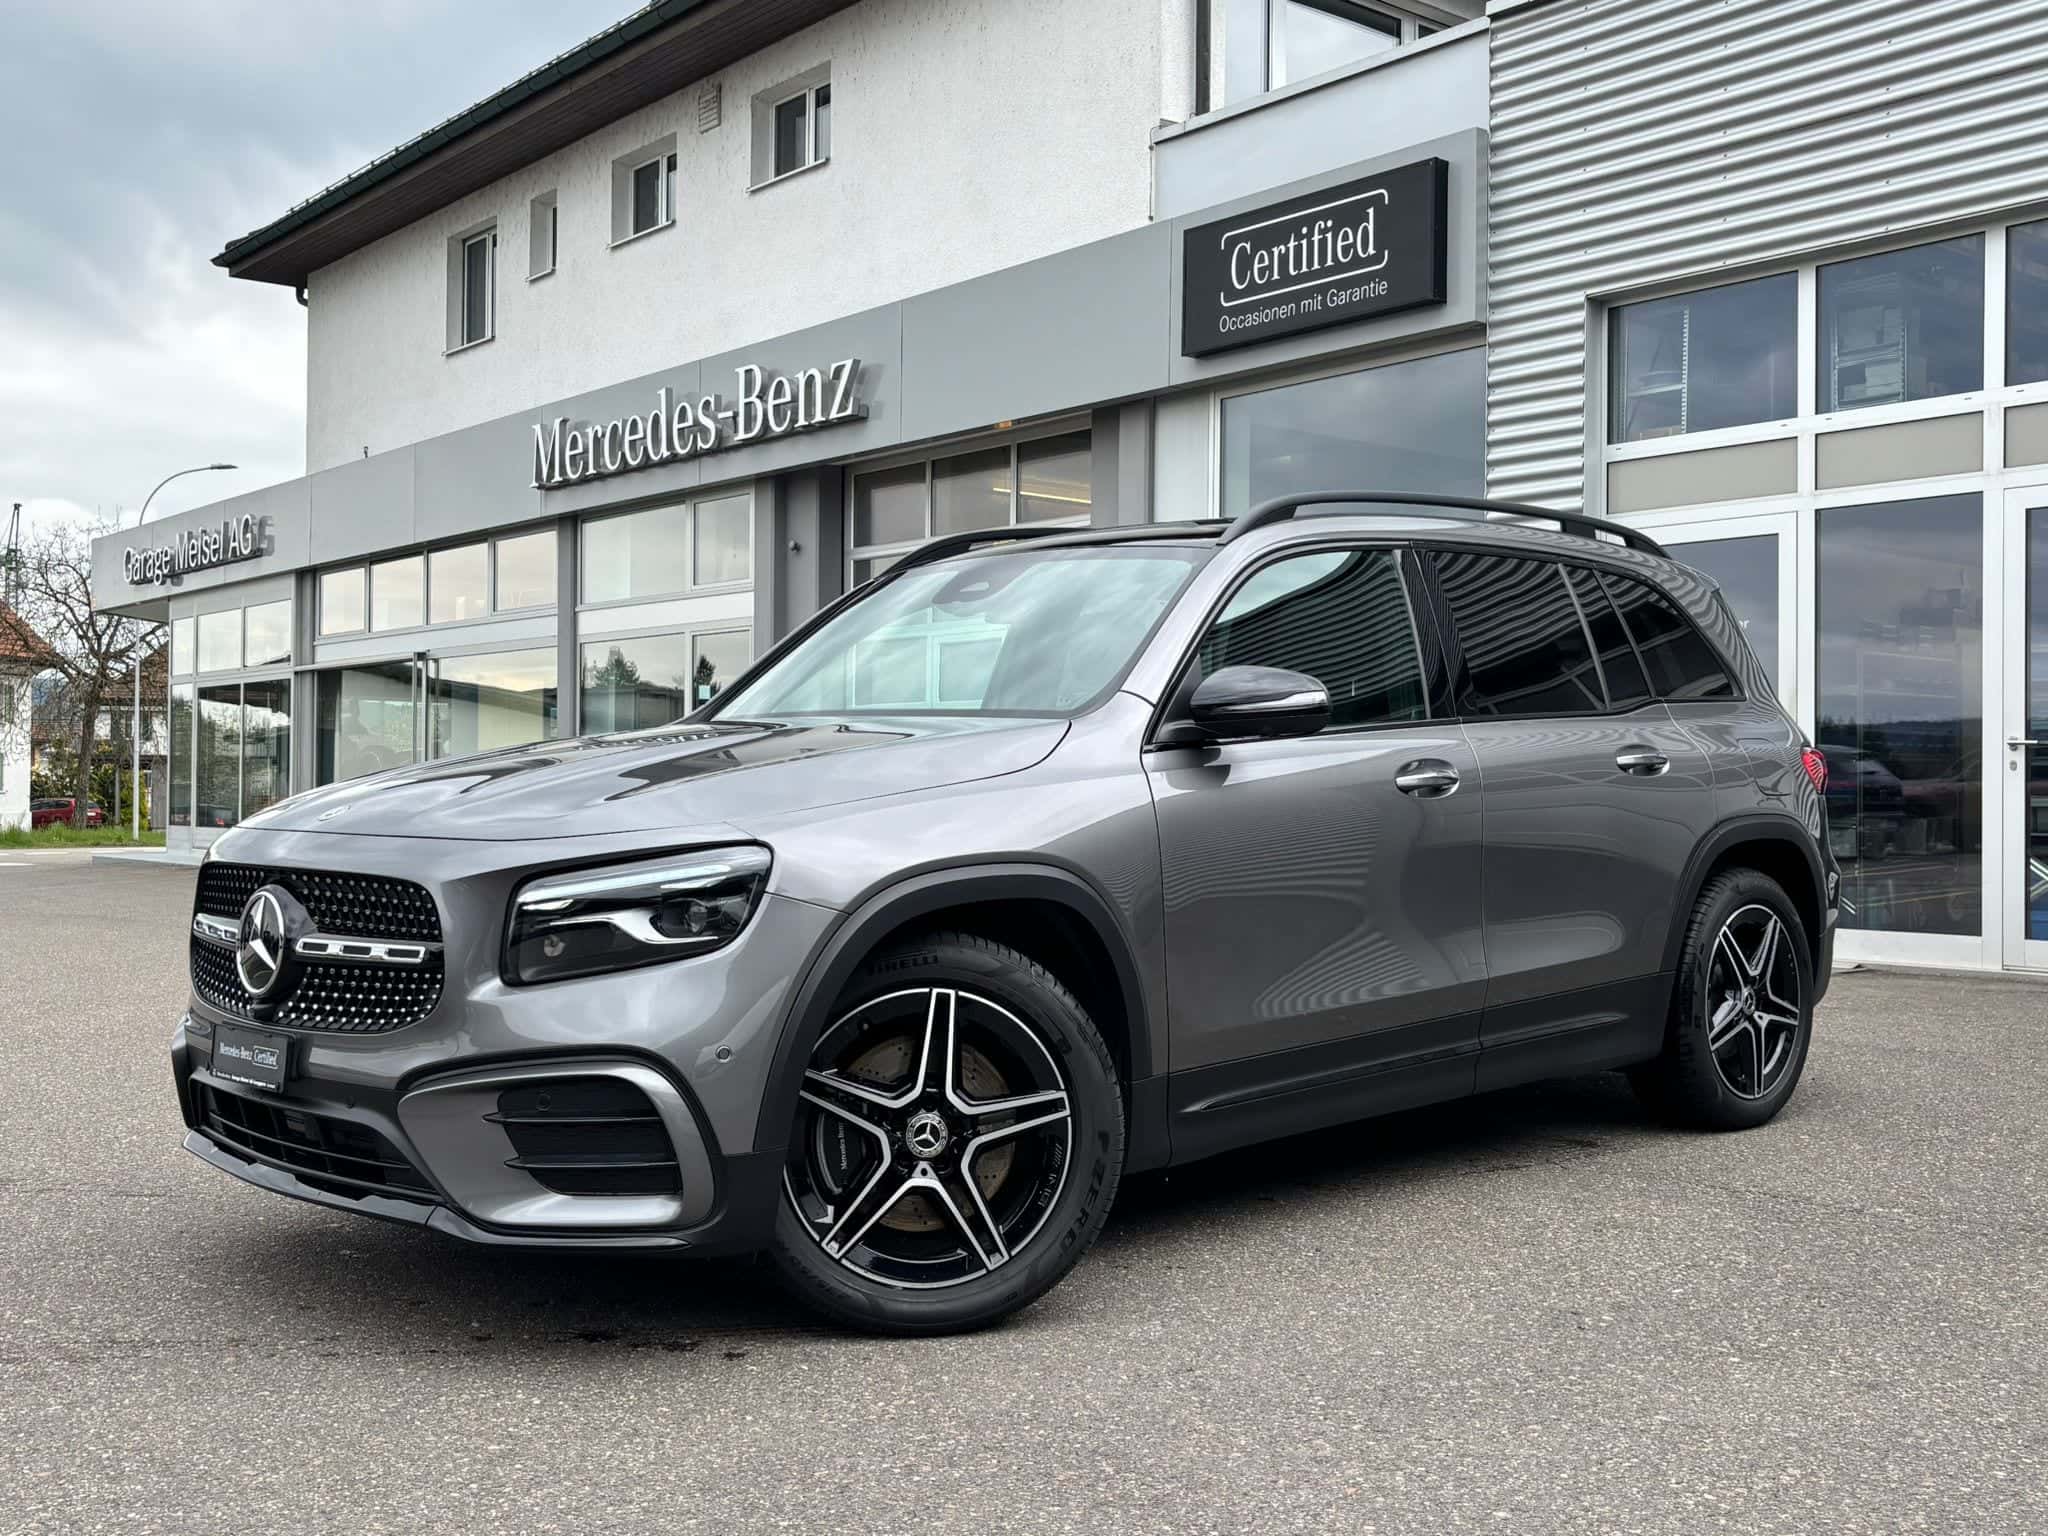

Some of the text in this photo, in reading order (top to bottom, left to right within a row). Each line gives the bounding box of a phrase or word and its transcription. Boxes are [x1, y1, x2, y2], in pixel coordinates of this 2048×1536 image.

[1231, 206, 1377, 290] Certified
[1219, 278, 1388, 333] Occasionen mit Garantie
[529, 358, 860, 488] Mercedes-Benz
[122, 513, 252, 586] Garage Meisel AG
